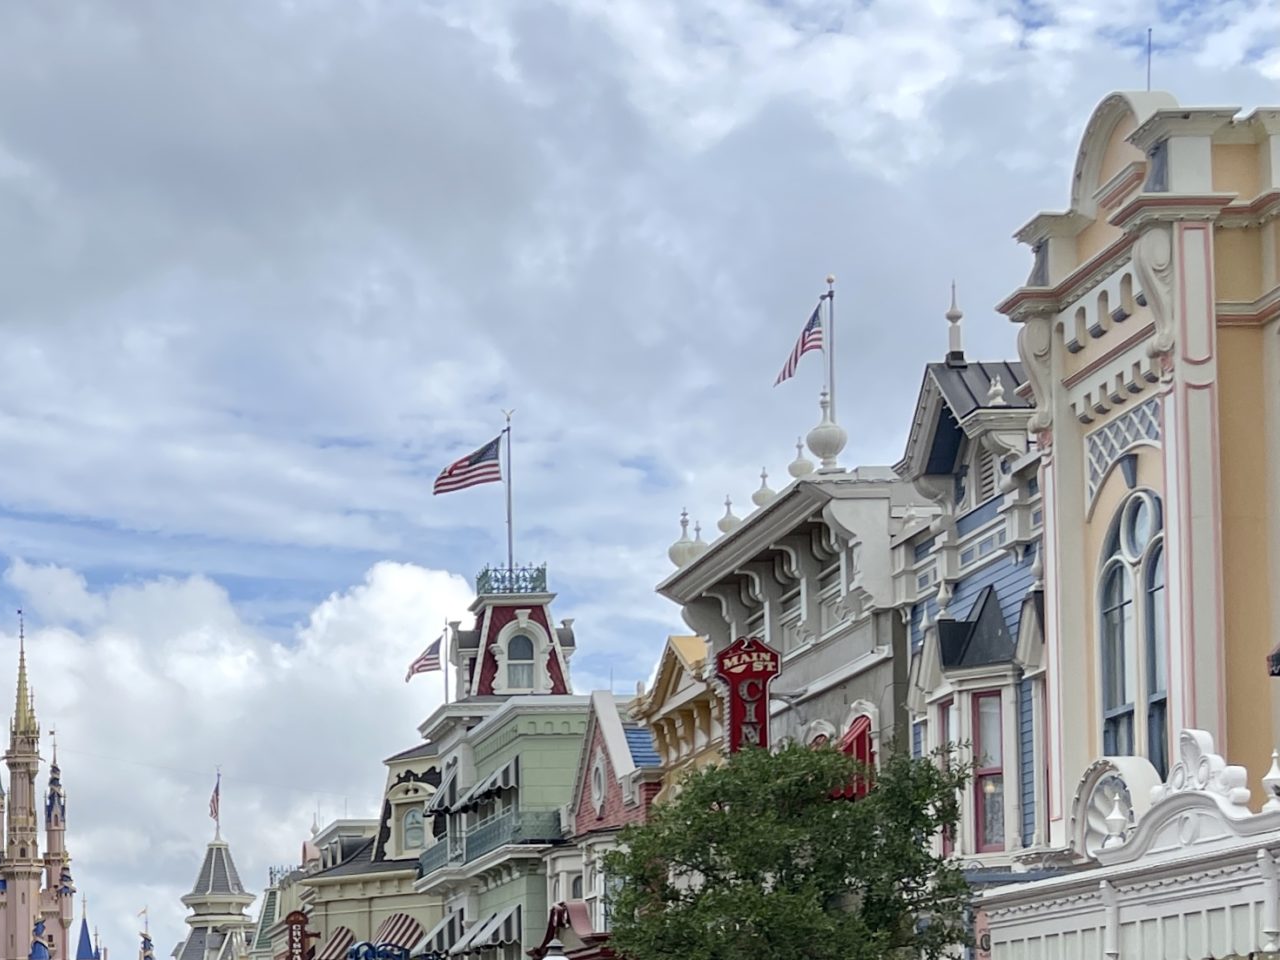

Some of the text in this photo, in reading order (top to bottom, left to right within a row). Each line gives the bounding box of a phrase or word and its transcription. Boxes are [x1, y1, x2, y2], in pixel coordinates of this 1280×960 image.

[722, 651, 772, 671] MAIN
[752, 661, 777, 672] ST.
[738, 680, 764, 745] CIN
